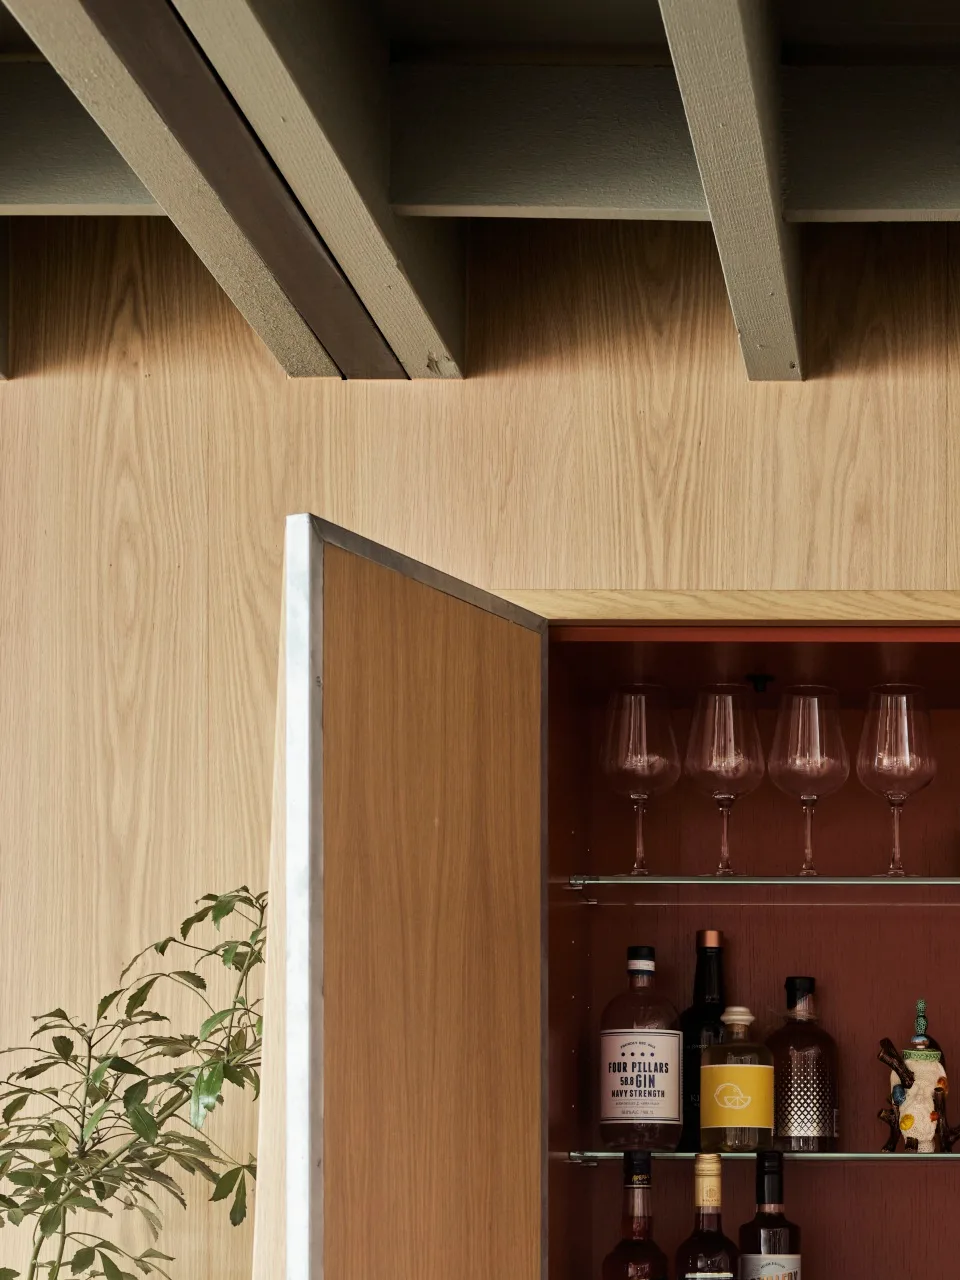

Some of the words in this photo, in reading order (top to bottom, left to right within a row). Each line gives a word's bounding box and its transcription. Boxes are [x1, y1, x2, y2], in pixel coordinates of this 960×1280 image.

[608, 1061, 628, 1074] FOUR
[631, 1061, 669, 1074] PILLARS
[620, 1076, 634, 1086] 58.8
[635, 1073, 656, 1089] GIN
[611, 1089, 629, 1098] NAVY
[629, 1089, 665, 1098] STRENGTH
